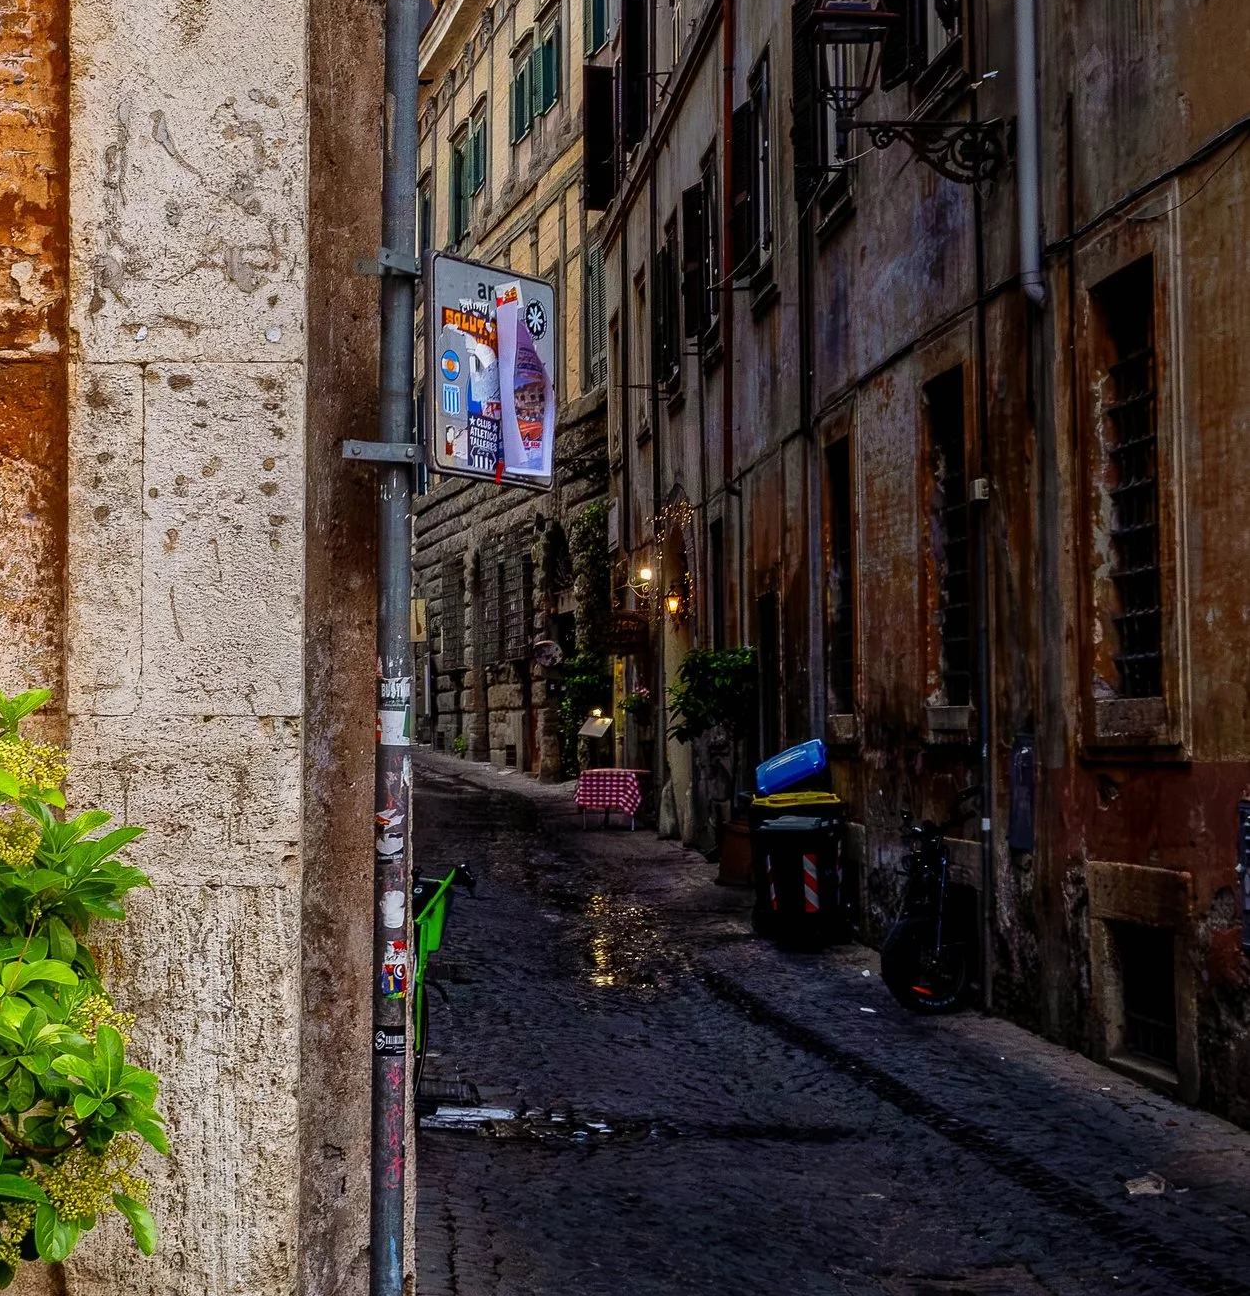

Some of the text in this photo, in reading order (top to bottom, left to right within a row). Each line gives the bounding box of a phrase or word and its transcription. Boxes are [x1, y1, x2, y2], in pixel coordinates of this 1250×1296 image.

[476, 418, 492, 430] CLUB
[469, 426, 498, 443] ATLETICO
[469, 436, 498, 452] TALLERES
